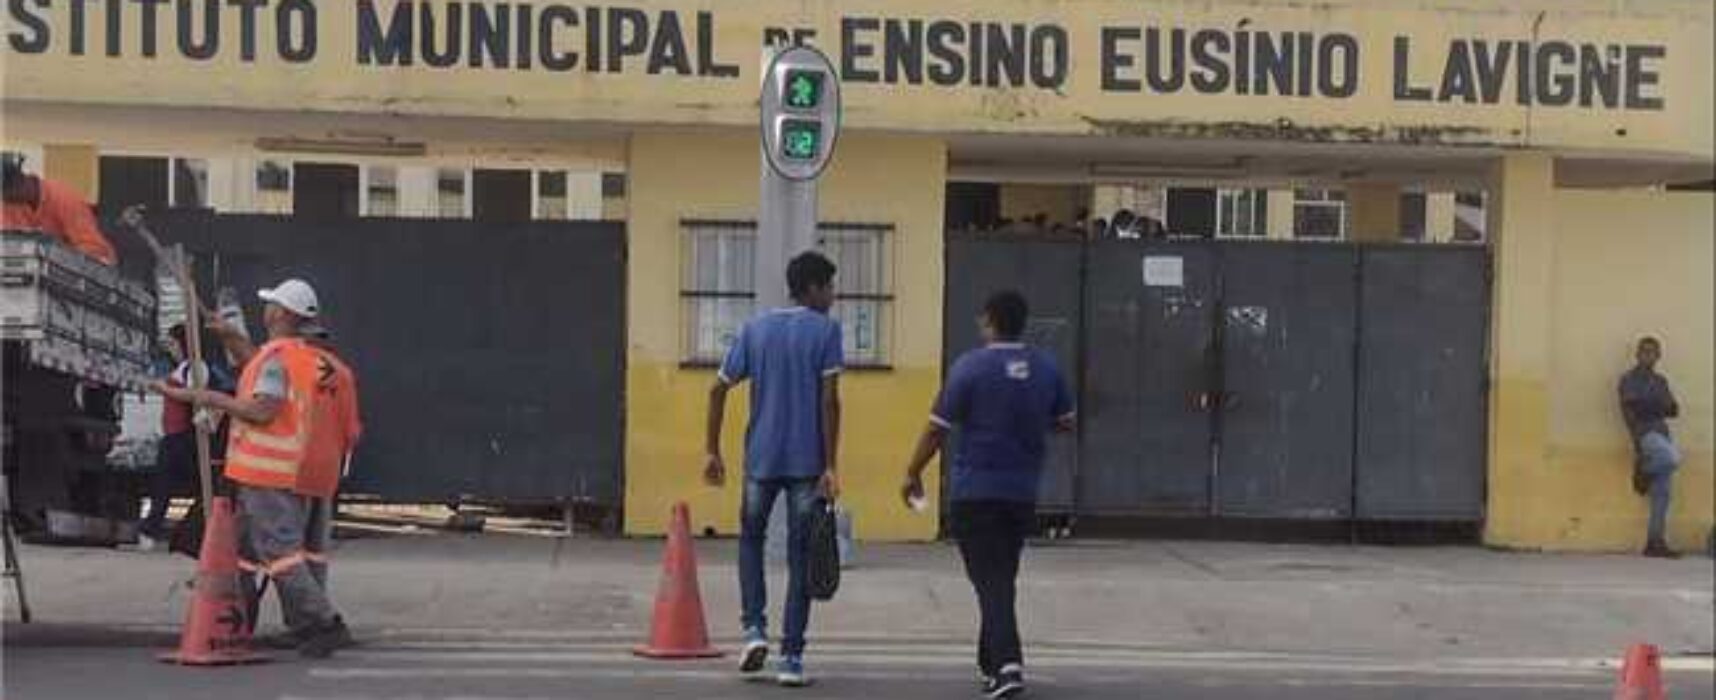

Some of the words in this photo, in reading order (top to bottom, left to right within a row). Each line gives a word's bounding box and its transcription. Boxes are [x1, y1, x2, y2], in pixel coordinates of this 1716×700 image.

[7, 0, 317, 63] STITUTO
[356, 1, 740, 77] MUNICIPAL
[1101, 18, 1359, 98] EUSÍNIO
[1394, 36, 1665, 109] LAVIGNE
